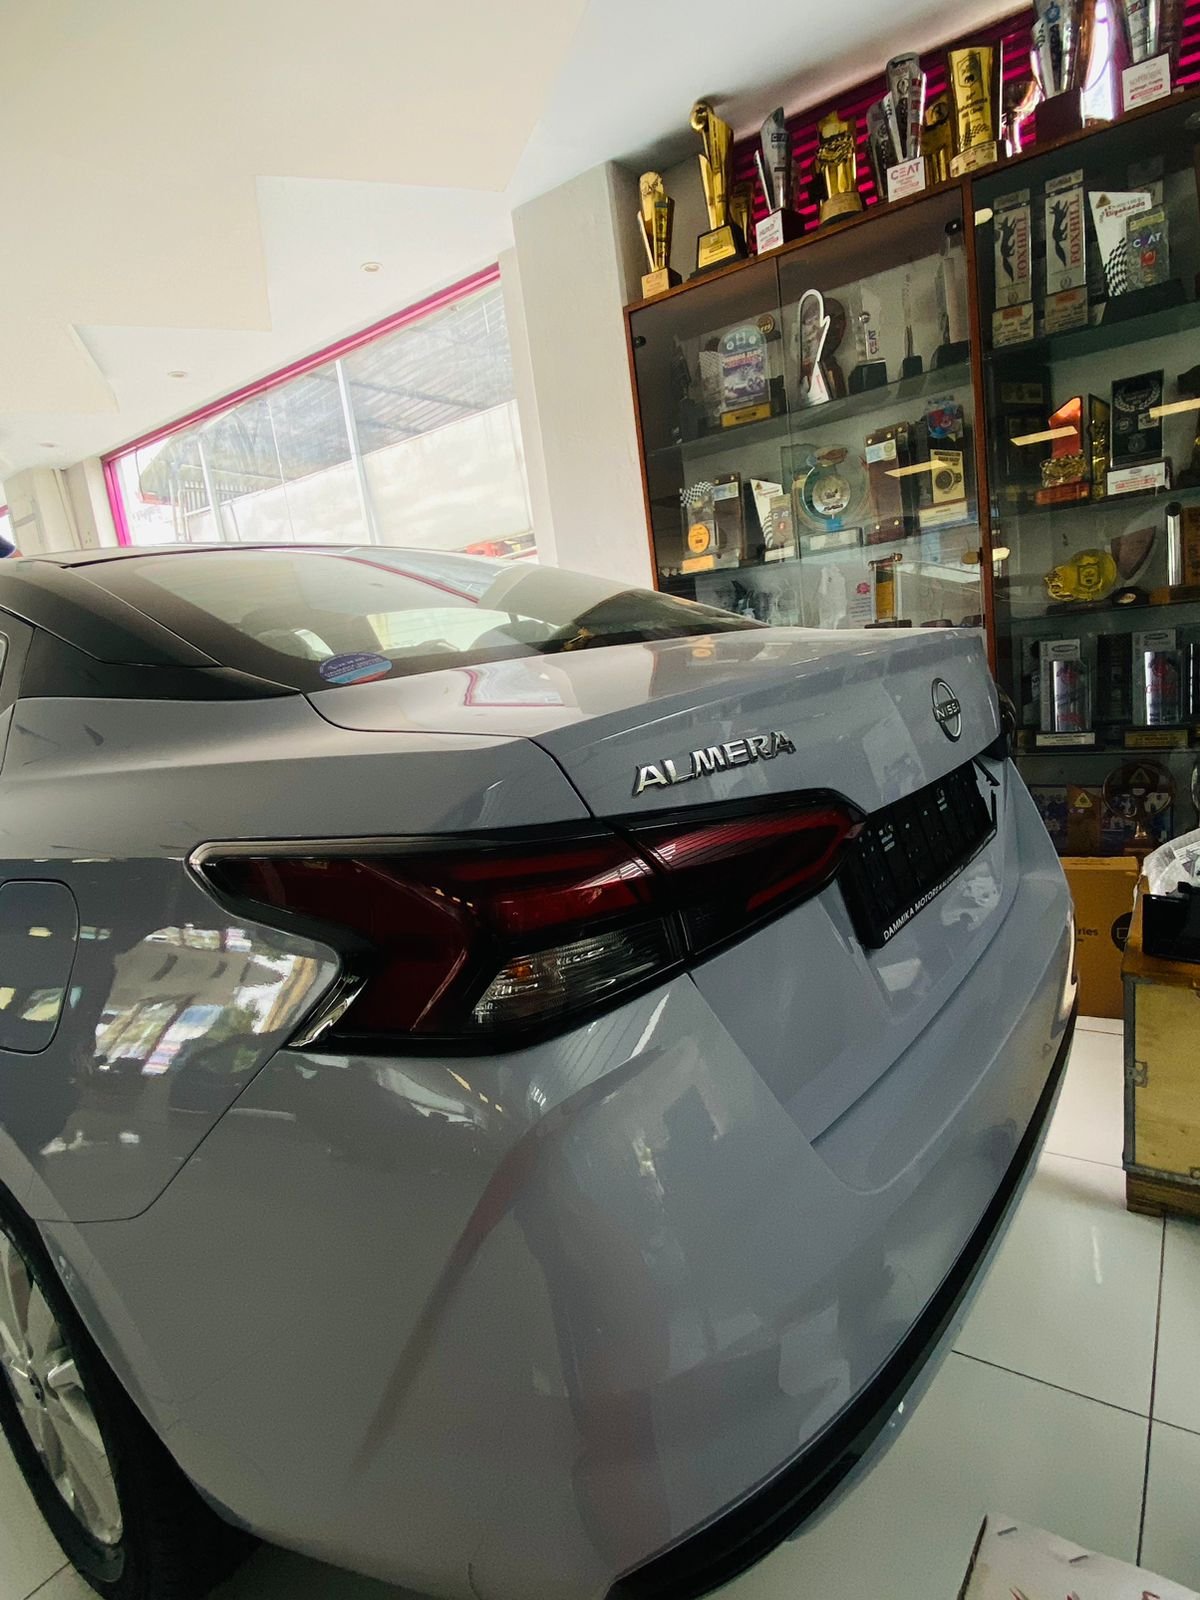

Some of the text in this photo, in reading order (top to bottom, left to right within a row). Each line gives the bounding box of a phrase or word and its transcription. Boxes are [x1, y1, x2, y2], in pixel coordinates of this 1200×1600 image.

[890, 161, 921, 180] CEAT
[1015, 216, 1028, 280] FOXHILL
[1069, 194, 1081, 266] FOXHILL
[632, 730, 796, 798] ALMERA
[883, 907, 914, 941] DAMMIKA
[914, 885, 939, 913] MOTORS
